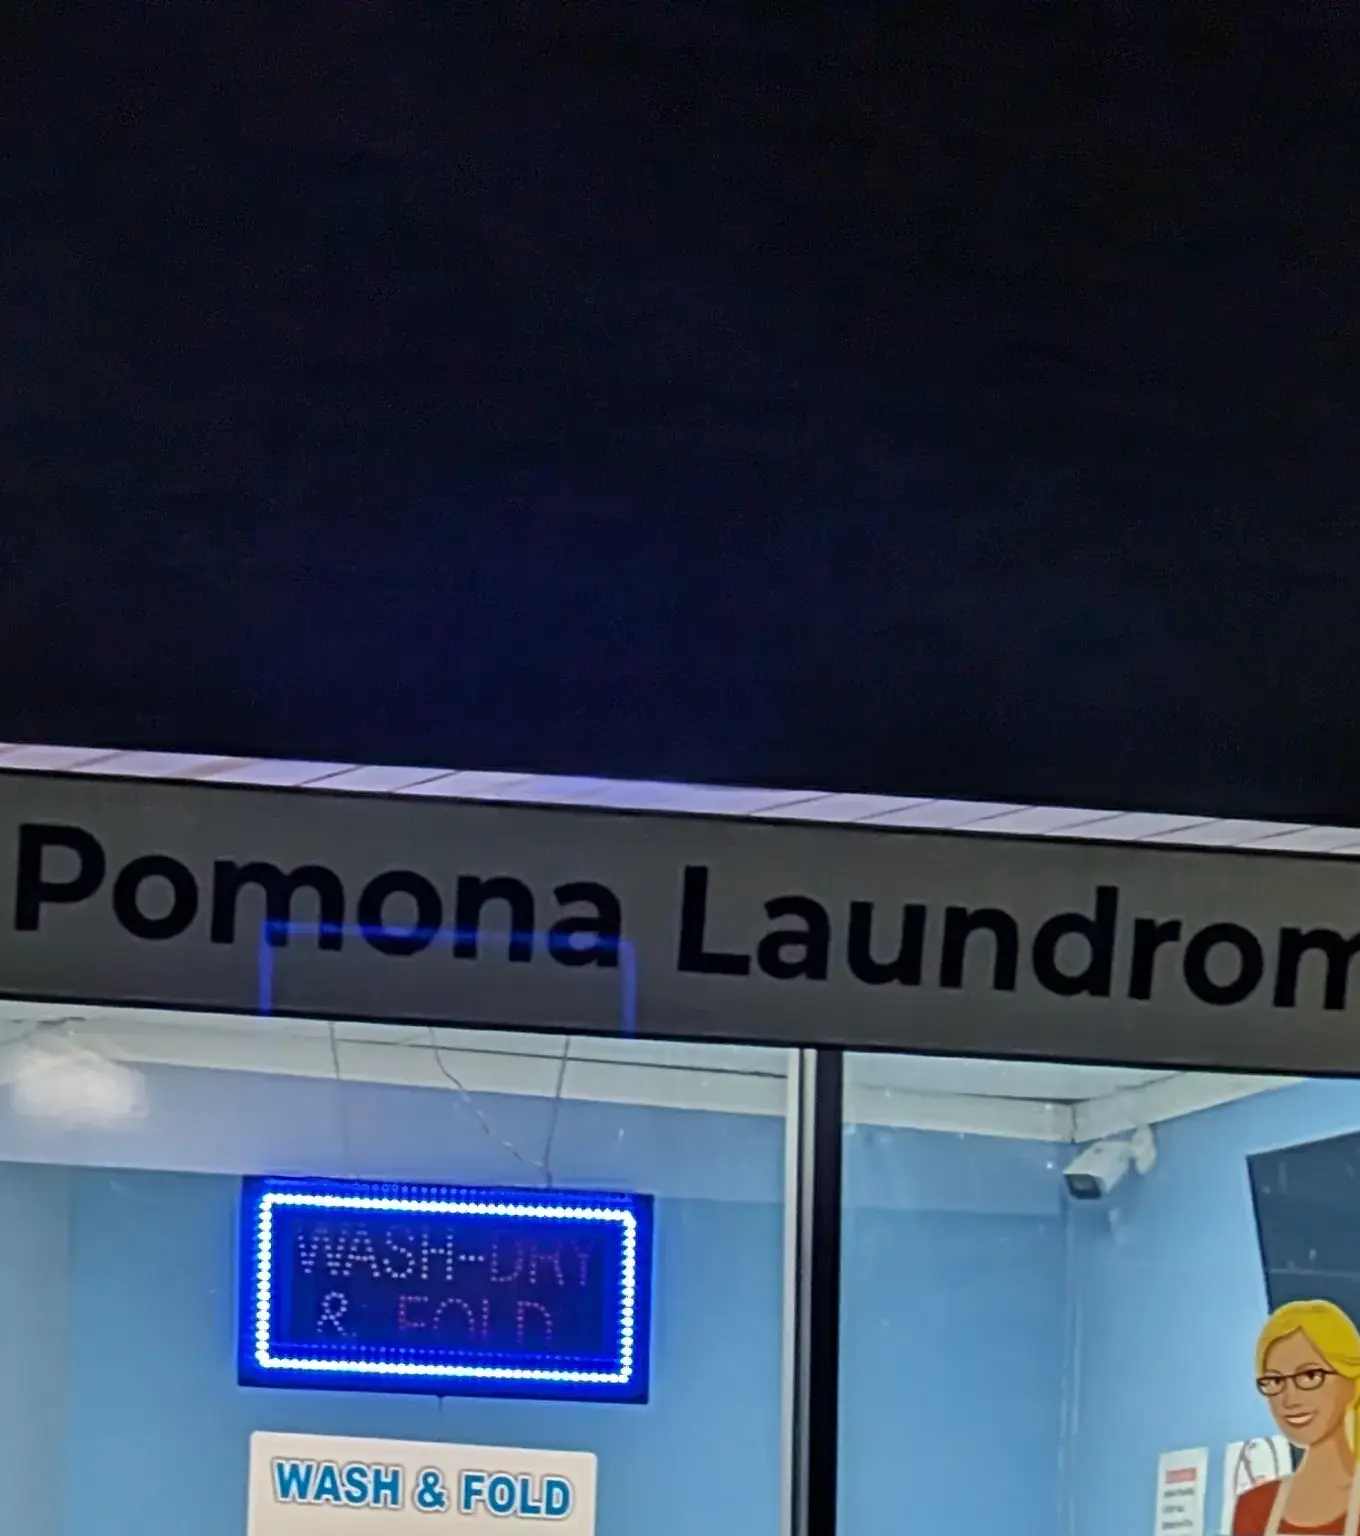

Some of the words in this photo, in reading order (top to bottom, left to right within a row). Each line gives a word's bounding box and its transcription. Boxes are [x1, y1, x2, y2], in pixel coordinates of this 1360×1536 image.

[13, 822, 622, 967] Pomona
[274, 1460, 402, 1506] WASH
[416, 1470, 447, 1509] &
[463, 1474, 571, 1517] FOLD
